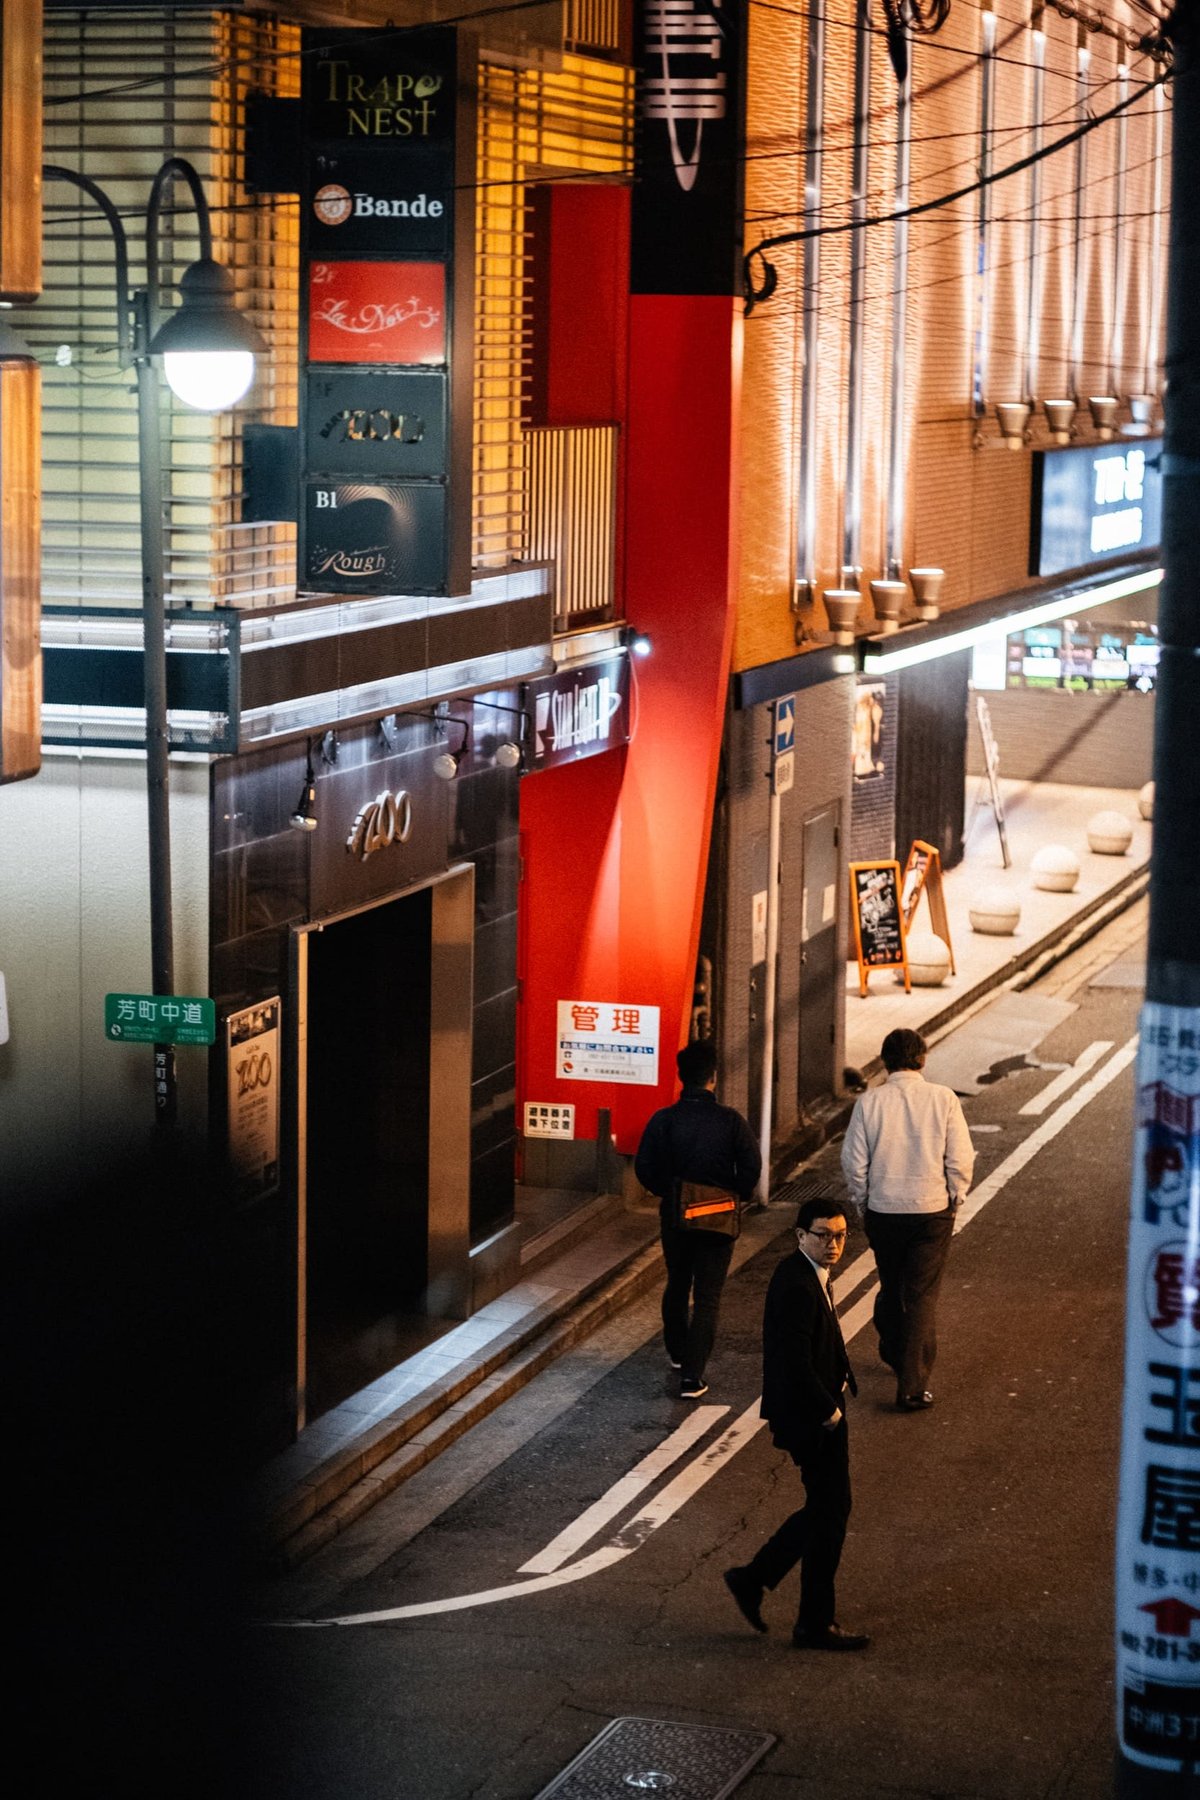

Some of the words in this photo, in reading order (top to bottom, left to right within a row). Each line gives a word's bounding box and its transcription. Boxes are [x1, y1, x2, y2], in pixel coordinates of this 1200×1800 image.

[353, 193, 444, 218] Bande
[315, 490, 338, 509] B1
[311, 550, 387, 576] Rough
[117, 999, 204, 1024] 芳町中道
[571, 1004, 641, 1035] 管理
